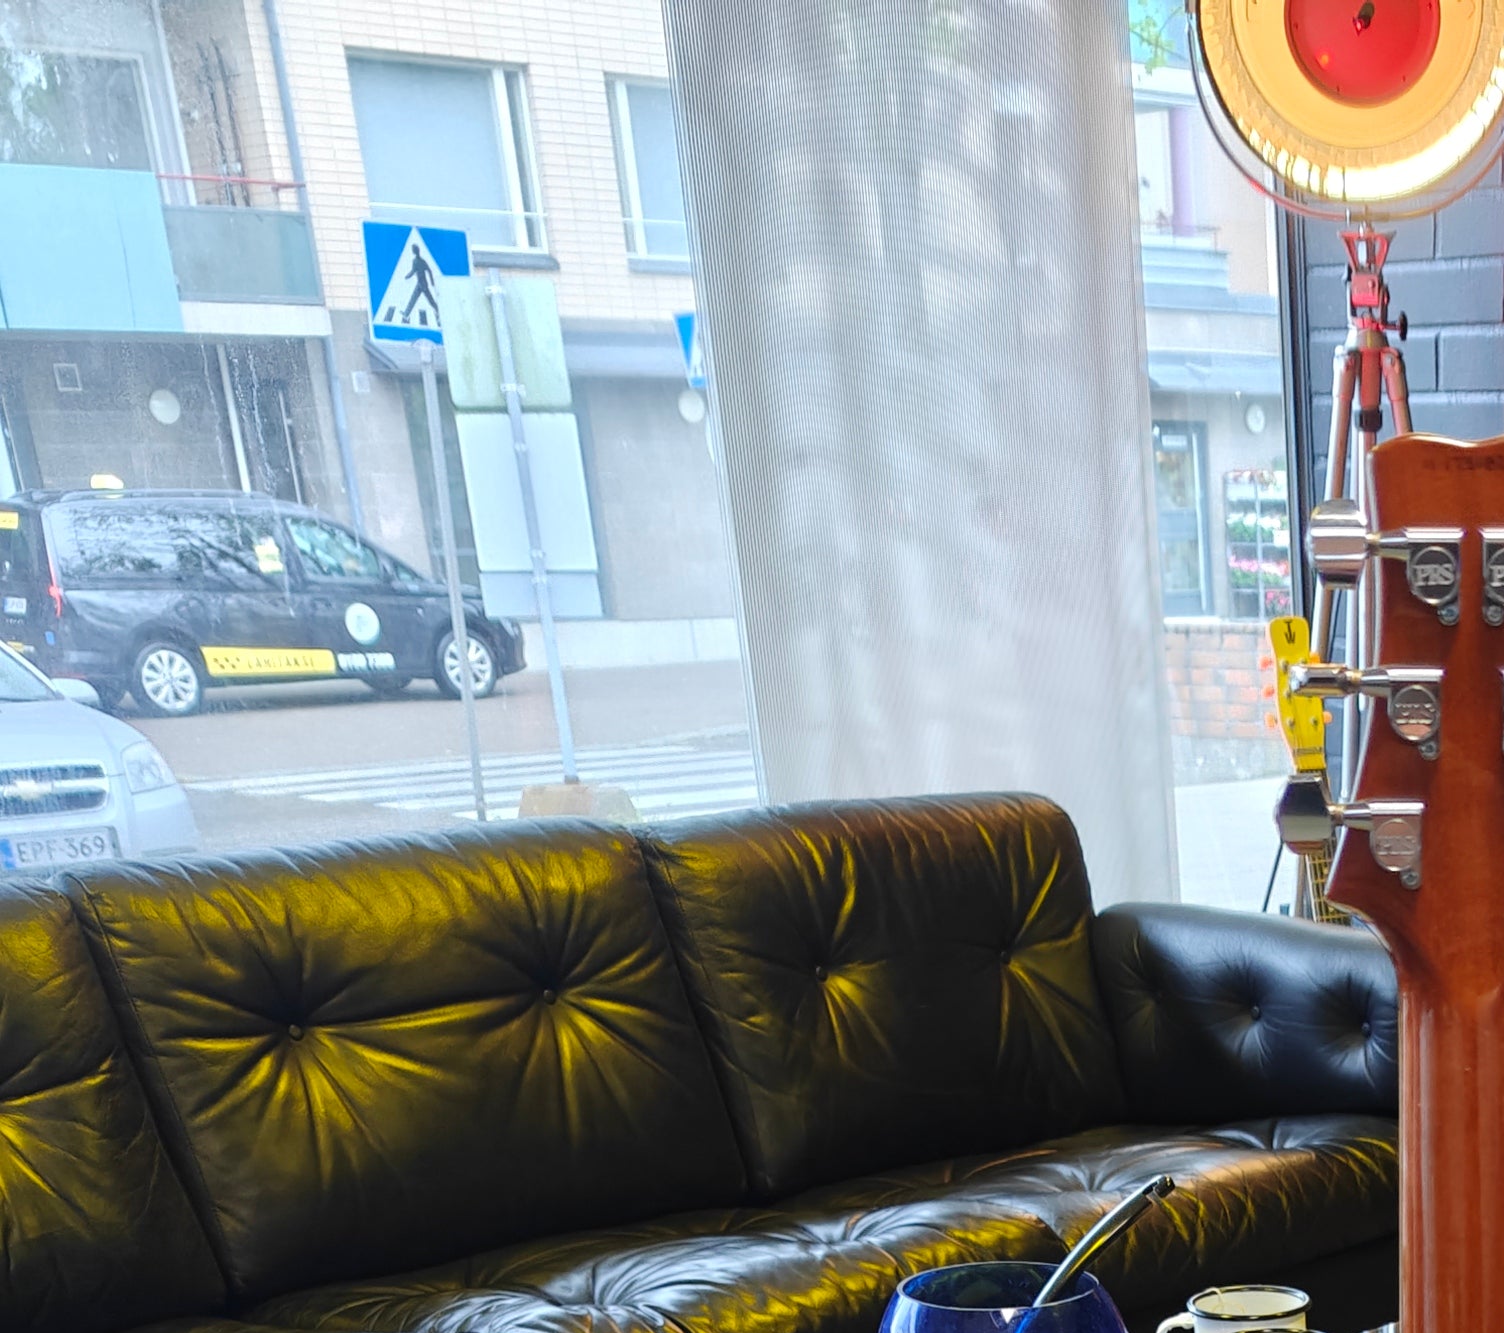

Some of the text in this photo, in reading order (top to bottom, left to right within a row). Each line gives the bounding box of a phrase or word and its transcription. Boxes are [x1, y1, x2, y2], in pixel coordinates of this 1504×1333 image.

[1414, 563, 1455, 586] PRS
[1394, 702, 1436, 725] PRS
[1376, 834, 1417, 856] PRS
